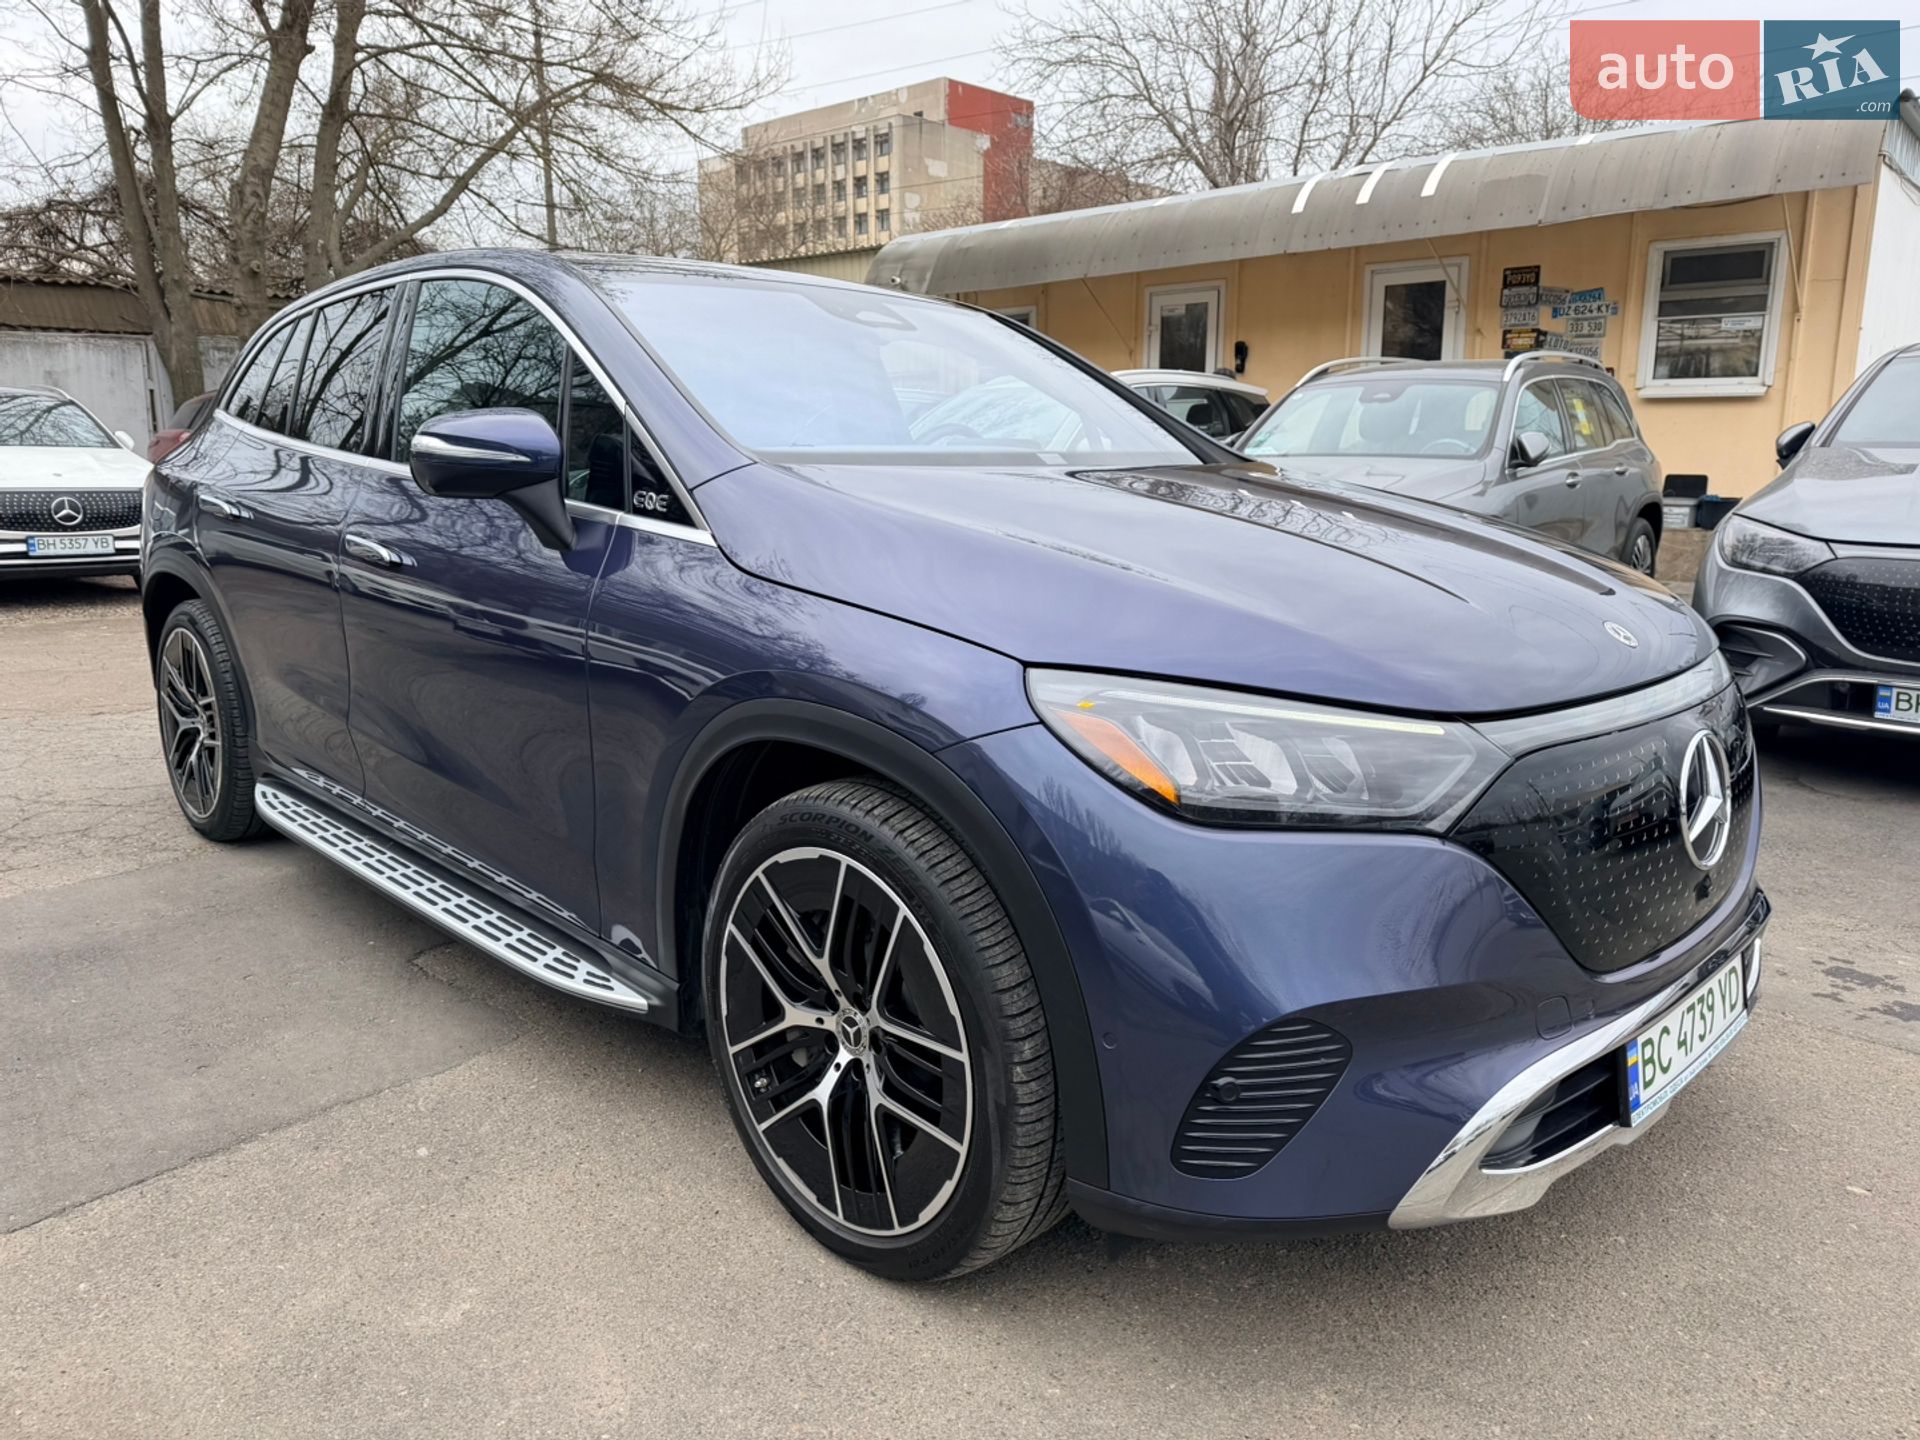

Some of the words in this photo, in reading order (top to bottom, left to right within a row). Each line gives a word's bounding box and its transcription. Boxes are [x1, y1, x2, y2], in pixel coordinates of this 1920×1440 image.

[633, 490, 669, 512] EQE
[37, 537, 57, 551] BH
[59, 537, 89, 550] 5357
[91, 537, 110, 549] YB
[777, 811, 876, 844] SCORPION
[1641, 1025, 1673, 1090] BC
[1677, 987, 1715, 1057] 4739
